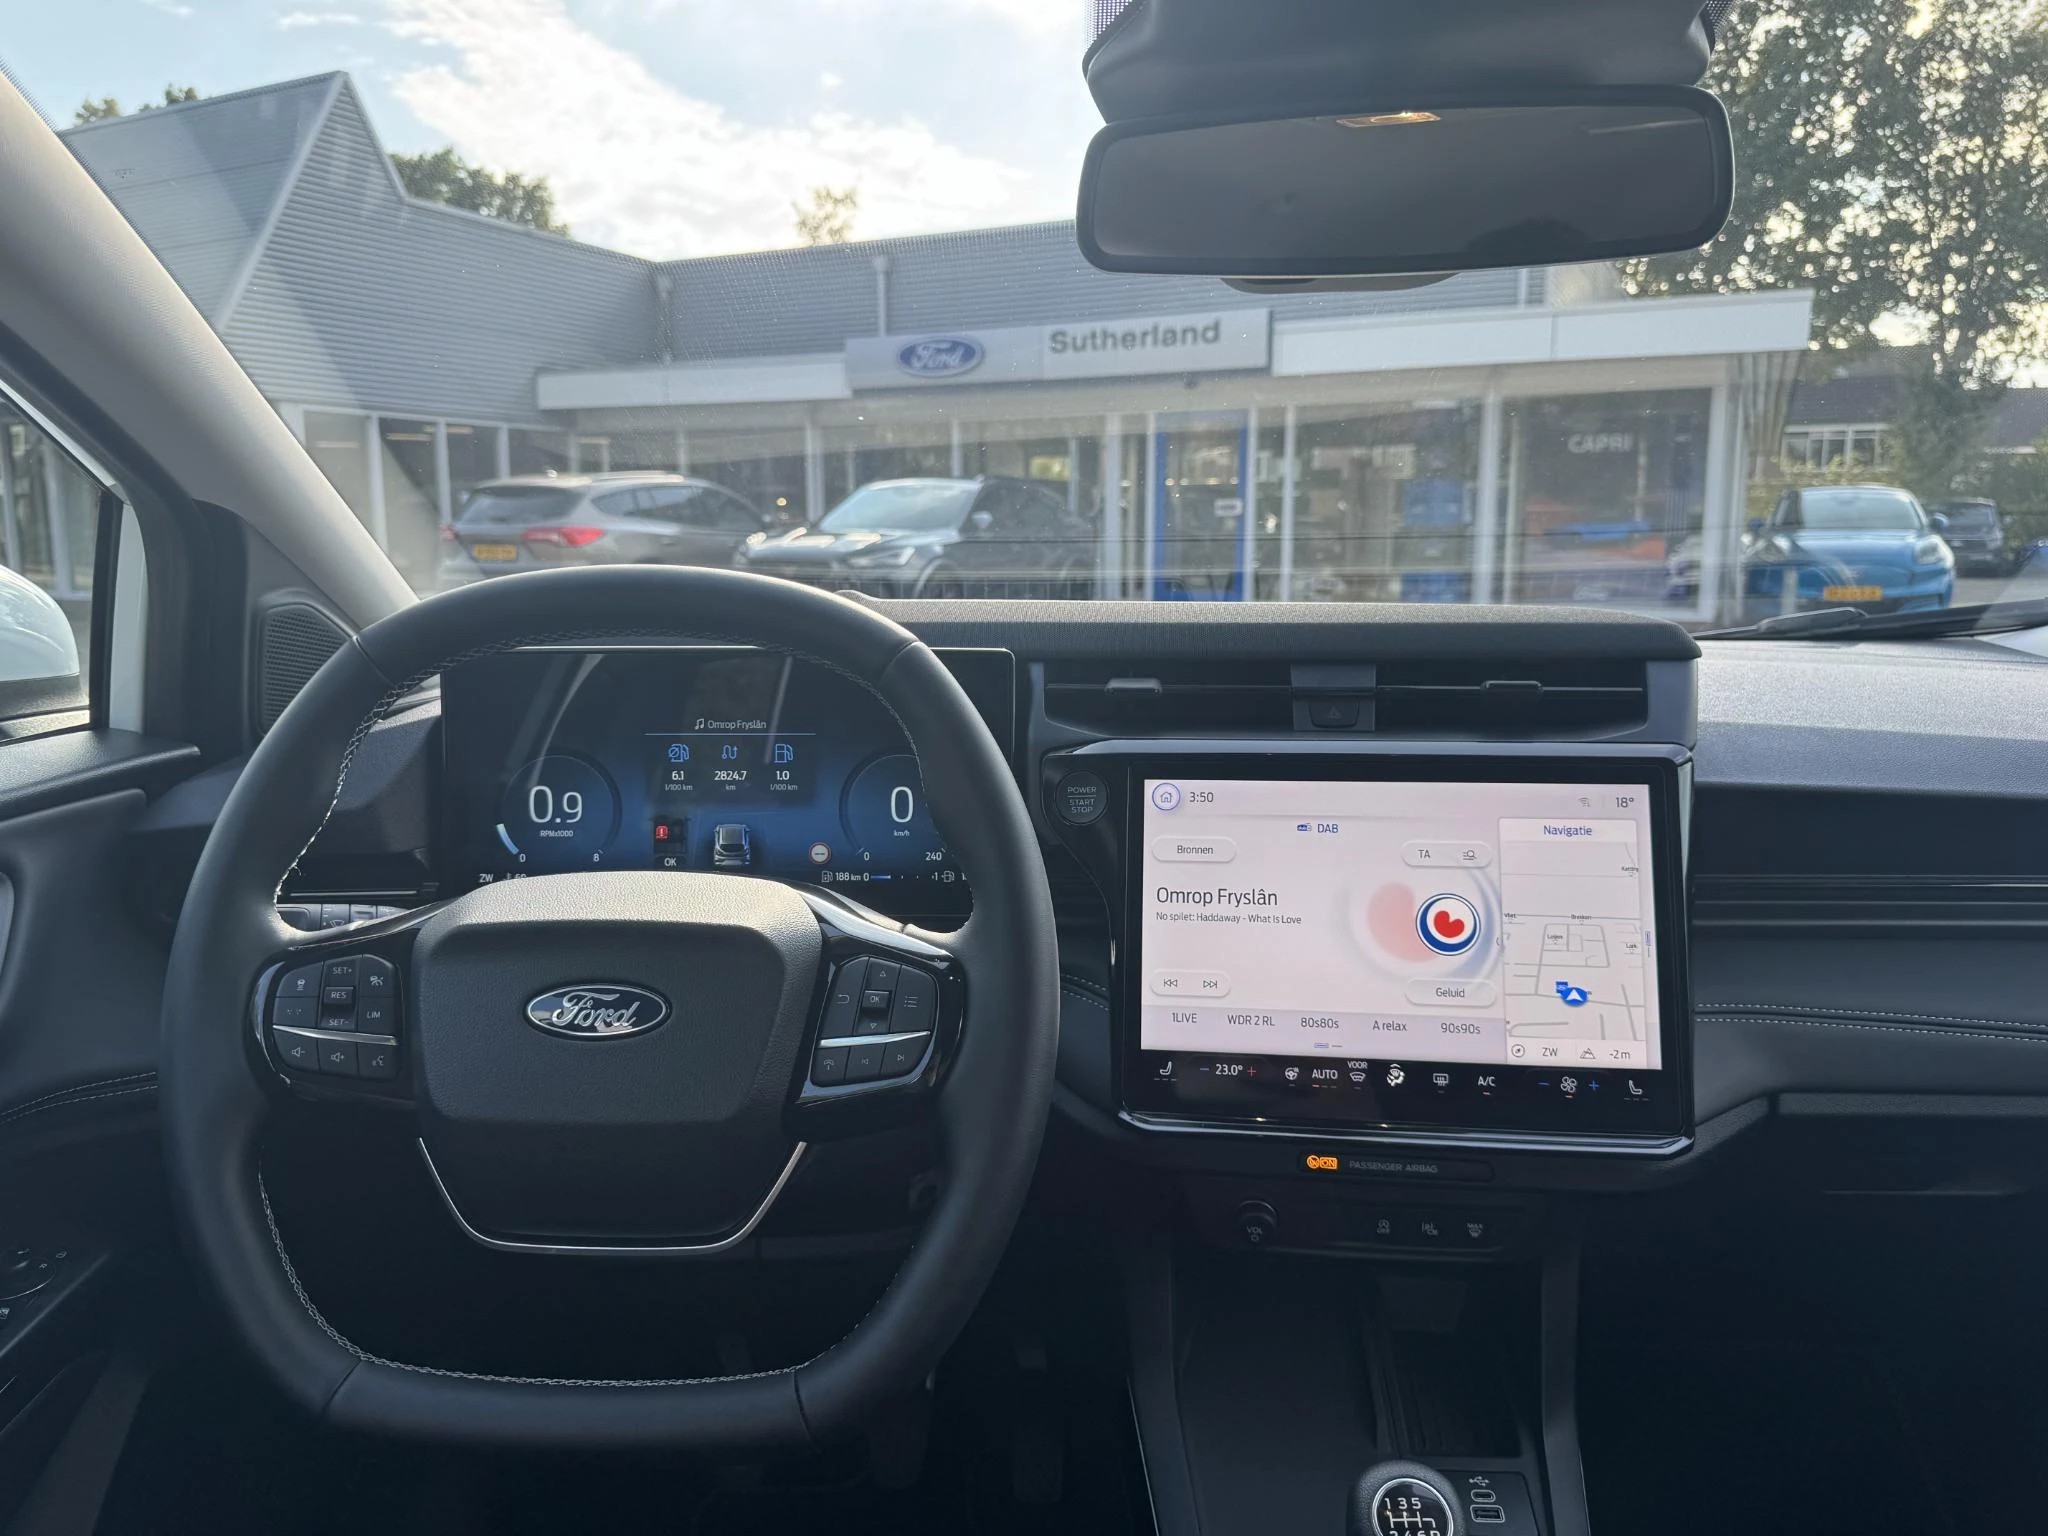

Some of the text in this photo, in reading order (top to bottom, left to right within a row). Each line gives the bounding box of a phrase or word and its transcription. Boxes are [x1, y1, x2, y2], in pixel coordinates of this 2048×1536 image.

[1049, 318, 1221, 355] Sutherland
[911, 342, 966, 369] Ford
[1567, 432, 1633, 454] CAPRI
[708, 719, 767, 731] Omrop Fryslân
[672, 770, 685, 781] 6.1
[714, 770, 747, 781] 2824.7
[776, 770, 790, 781] 1.0
[682, 783, 693, 791] km
[725, 783, 736, 791] km
[788, 783, 798, 791] km
[1067, 786, 1097, 794] POWER
[1069, 798, 1095, 806] START
[1189, 792, 1214, 803] 3:50
[1615, 796, 1634, 808] 18°
[529, 785, 583, 823] 0.9
[891, 786, 914, 823] 0
[1071, 806, 1093, 814] STOP
[540, 830, 574, 838] RPMx1000
[1317, 823, 1339, 834] DAB
[1543, 824, 1592, 837] Navigatie
[1176, 844, 1214, 855] Bronnen
[1417, 849, 1431, 859] TA
[519, 853, 526, 863] 0
[593, 853, 600, 862] 8
[664, 857, 677, 867] OK
[863, 852, 870, 861] 0
[925, 852, 942, 861] 240
[479, 873, 494, 883] ZW
[835, 872, 850, 881] 188
[851, 873, 861, 881] km
[863, 872, 870, 882] 0
[1156, 886, 1278, 908] Omrop Fryslân
[1156, 911, 1168, 921] No
[1169, 912, 1195, 924] spilet:
[1196, 913, 1241, 924] Haddaway
[1248, 914, 1271, 923] What
[1272, 914, 1280, 923] Is
[1281, 914, 1302, 924] Love
[332, 966, 352, 975] SET+
[331, 991, 347, 999] RES
[1435, 987, 1465, 998] Geluid
[869, 995, 881, 1003] OK
[366, 1011, 381, 1019] LIM
[551, 991, 641, 1028] Ford
[1172, 1012, 1197, 1023] 1LIVE
[1227, 1014, 1275, 1026] WDR 2 RL
[1300, 1017, 1339, 1029] 80s80s
[1372, 1020, 1408, 1031] A relax
[1440, 1022, 1481, 1034] 90s90s
[1542, 1047, 1558, 1057] ZW
[1620, 1051, 1631, 1060] m
[1215, 1063, 1243, 1076] 23.0°
[1347, 1060, 1368, 1070] VOOR
[1312, 1069, 1339, 1080] AUTO
[1477, 1076, 1496, 1087] A/C
[1349, 1160, 1438, 1174] PASSENGER AIRBAG
[1384, 1497, 1422, 1510] 1 3 5
